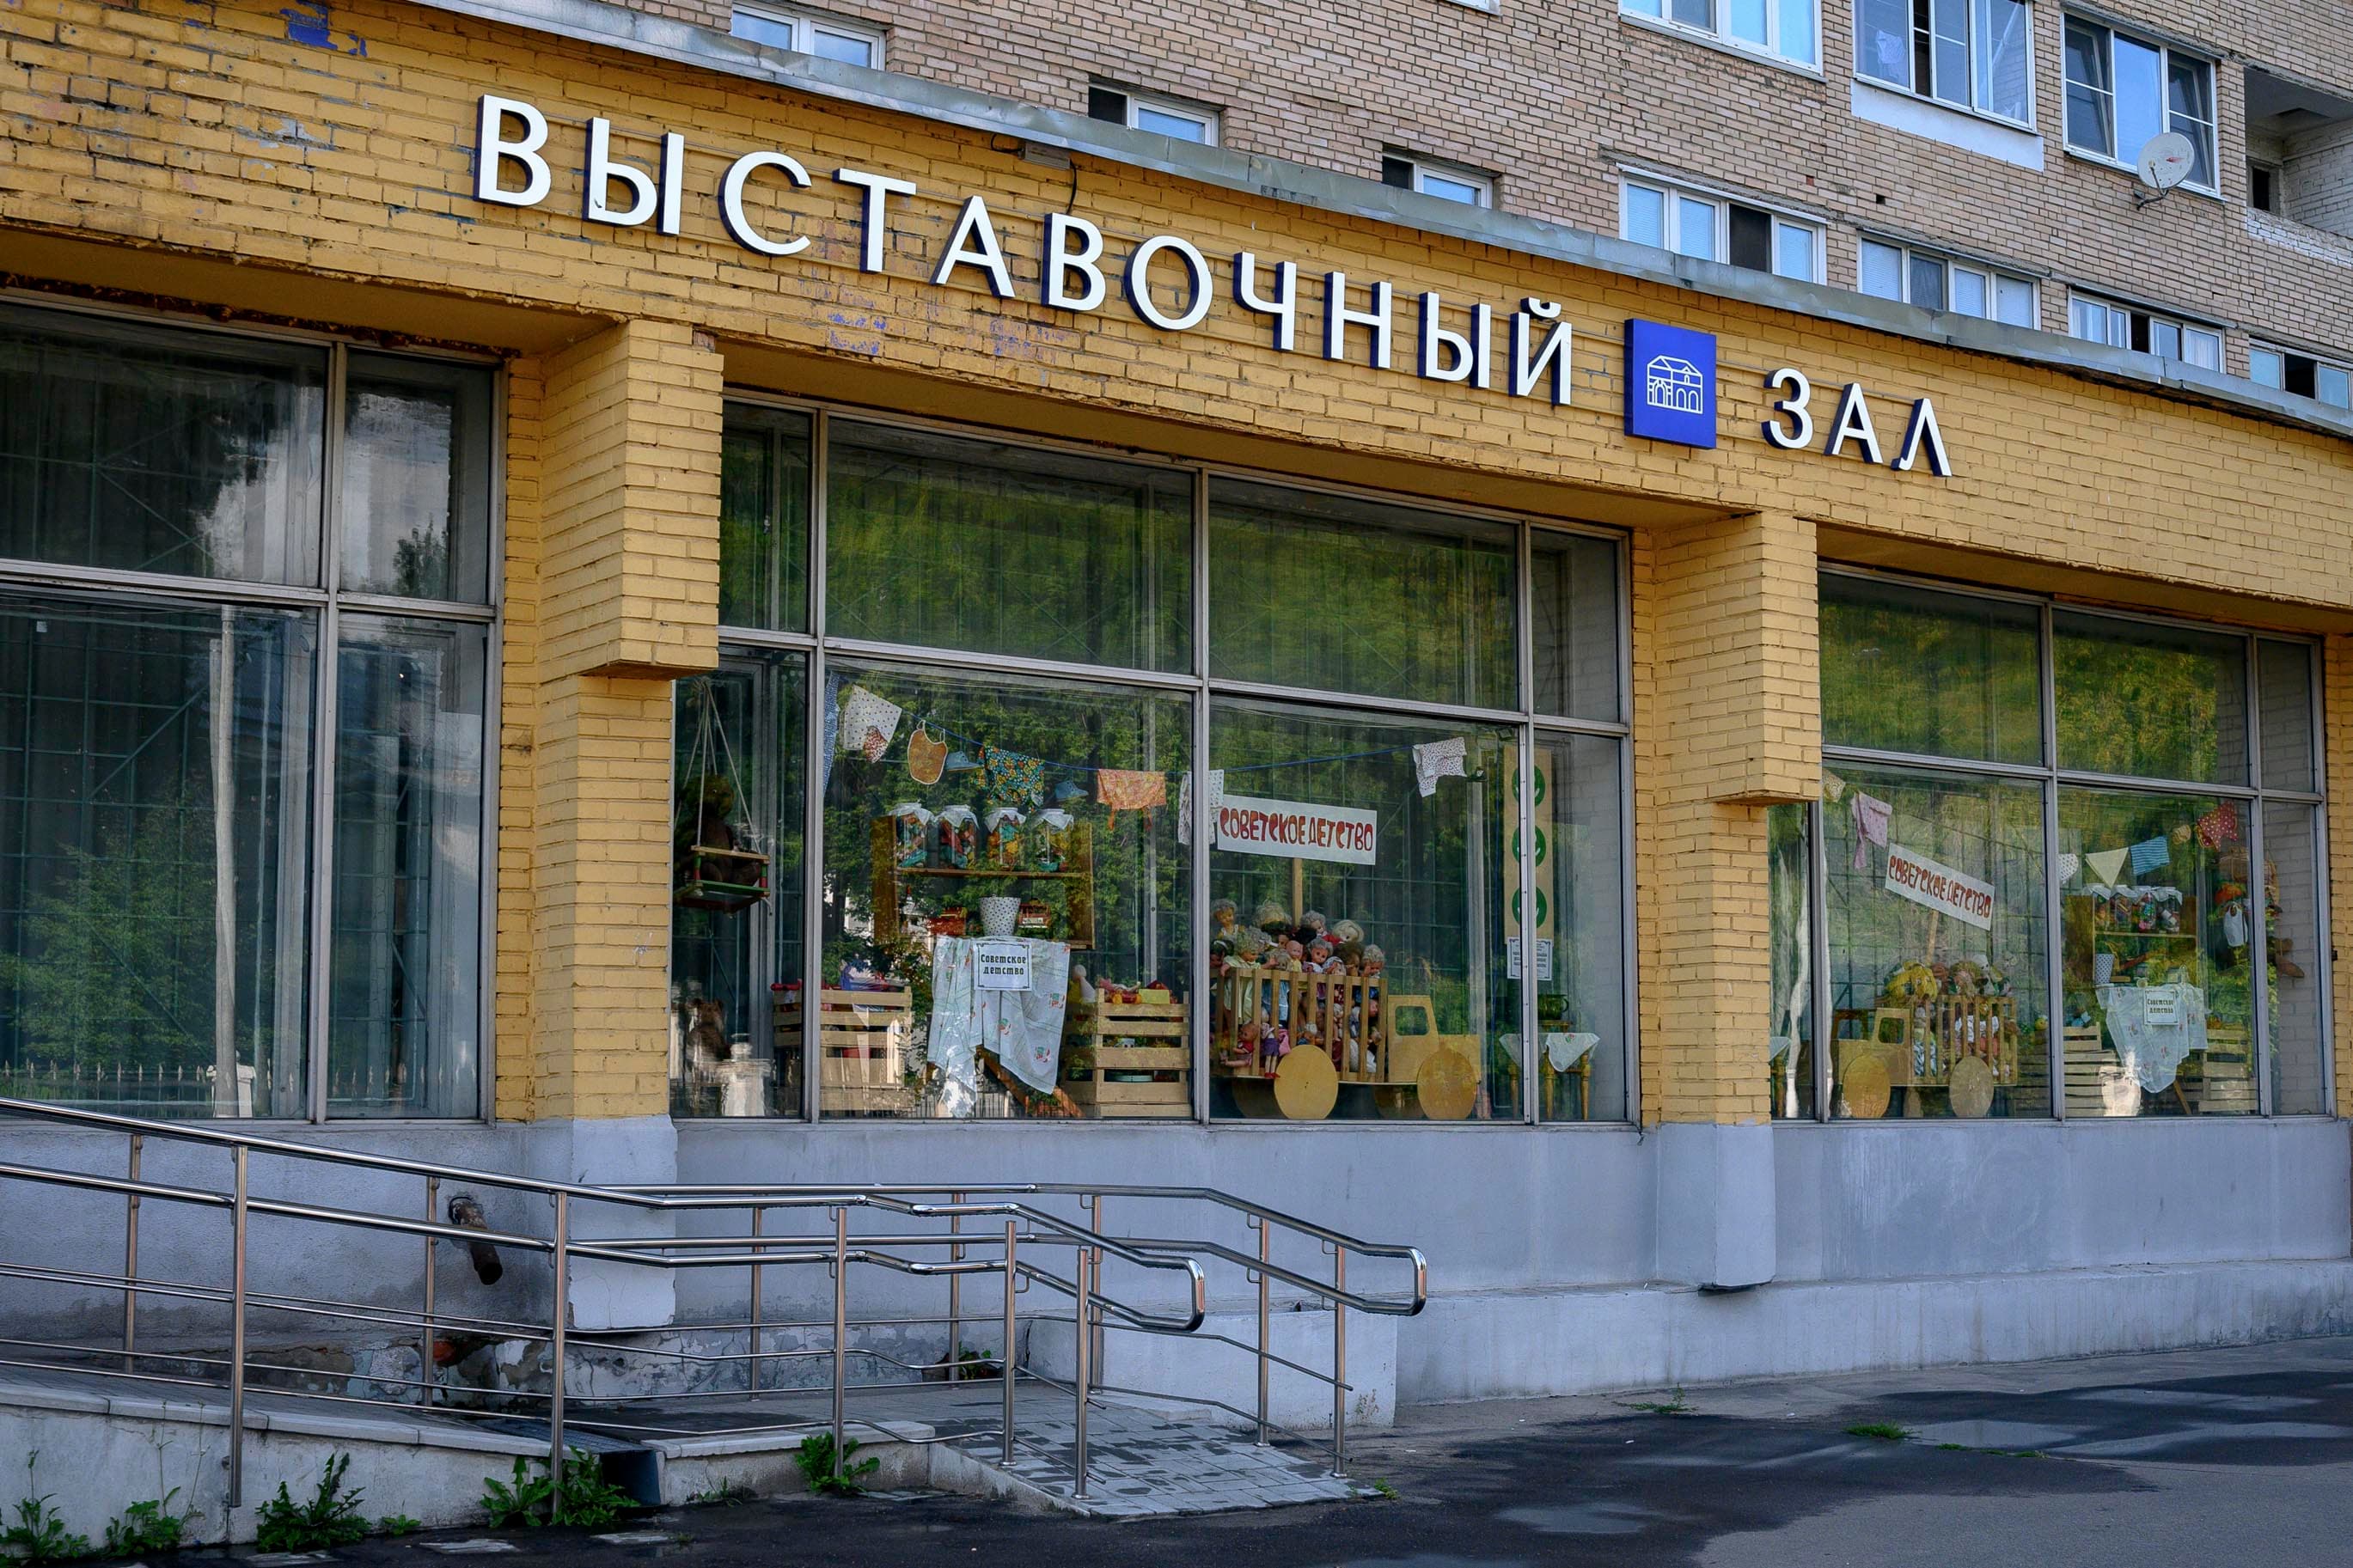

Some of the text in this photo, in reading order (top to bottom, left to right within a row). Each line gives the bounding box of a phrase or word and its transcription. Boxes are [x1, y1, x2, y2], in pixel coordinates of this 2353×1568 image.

[474, 94, 1953, 478] ВЫСТАВОЧНЫЙ ЗАЛ
[1220, 808, 1373, 851] СОВЕТСКОЕ ДЕТСТВО
[1890, 856, 1991, 918] СОВЕТСКОЕ ДЕТСТВО
[981, 954, 1026, 964] Советское
[983, 967, 1024, 975] детство
